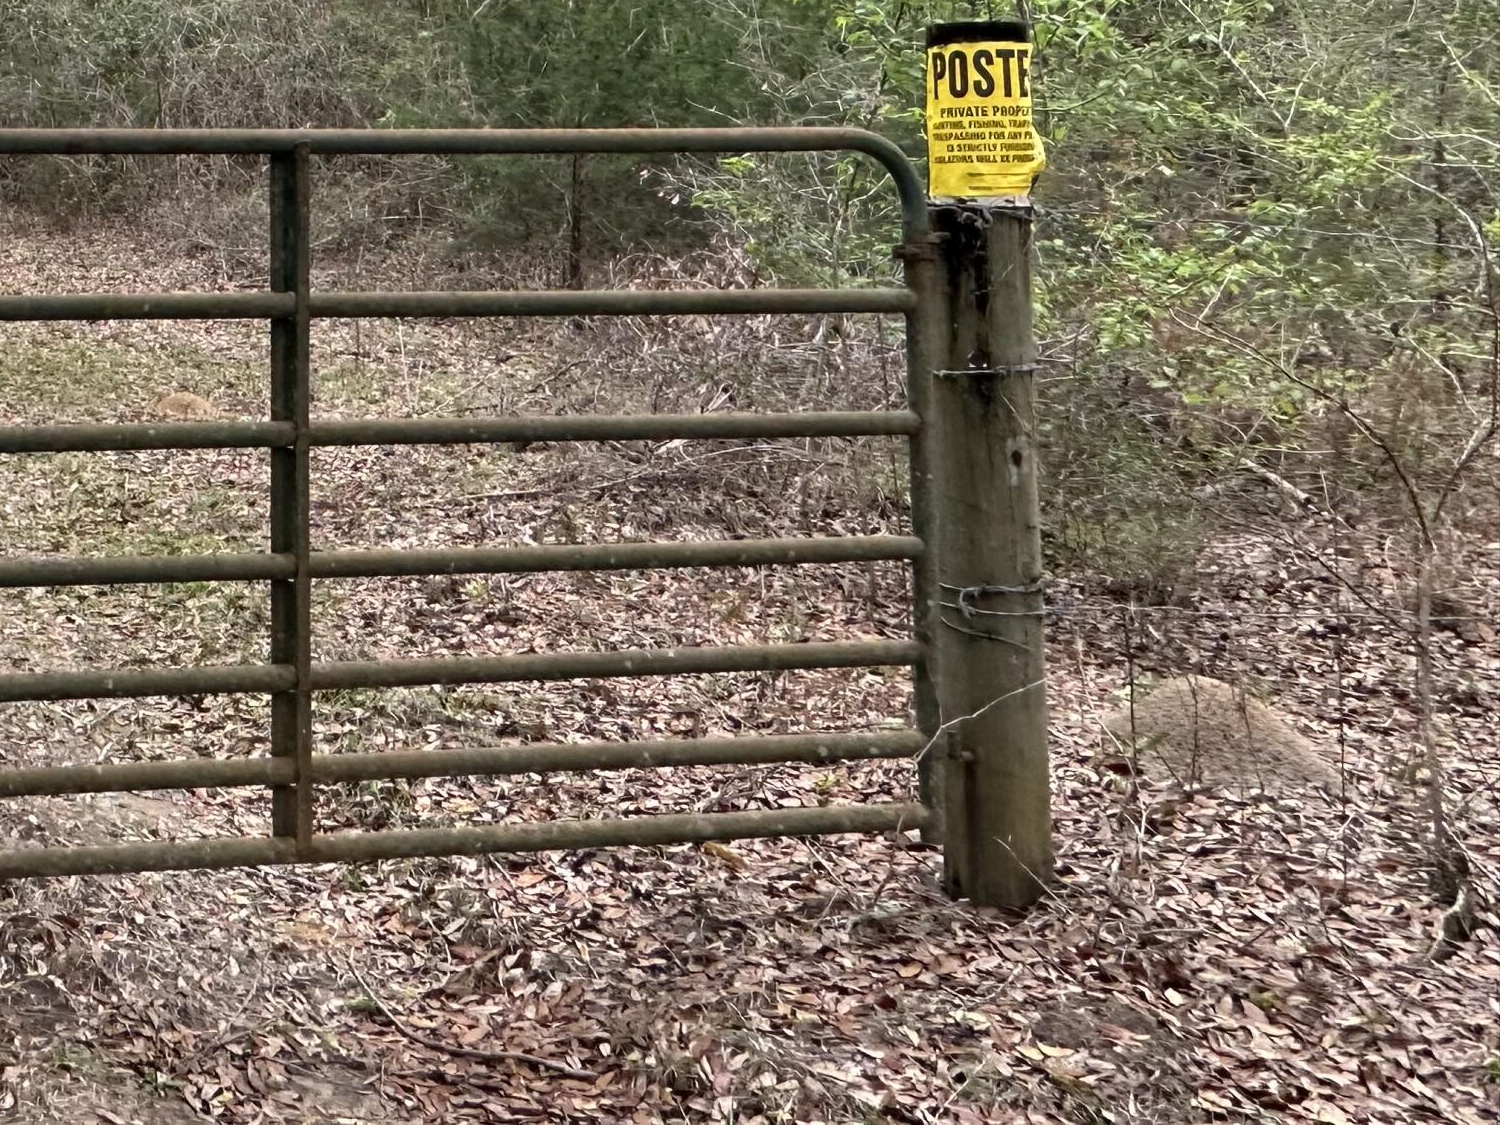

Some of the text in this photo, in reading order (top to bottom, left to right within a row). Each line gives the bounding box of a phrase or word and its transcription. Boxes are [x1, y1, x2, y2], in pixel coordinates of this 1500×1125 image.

[932, 49, 1028, 99] POSTE
[941, 106, 988, 118] PRIVATE
[989, 131, 1005, 139] FOR
[957, 144, 997, 152] STRICTLY
